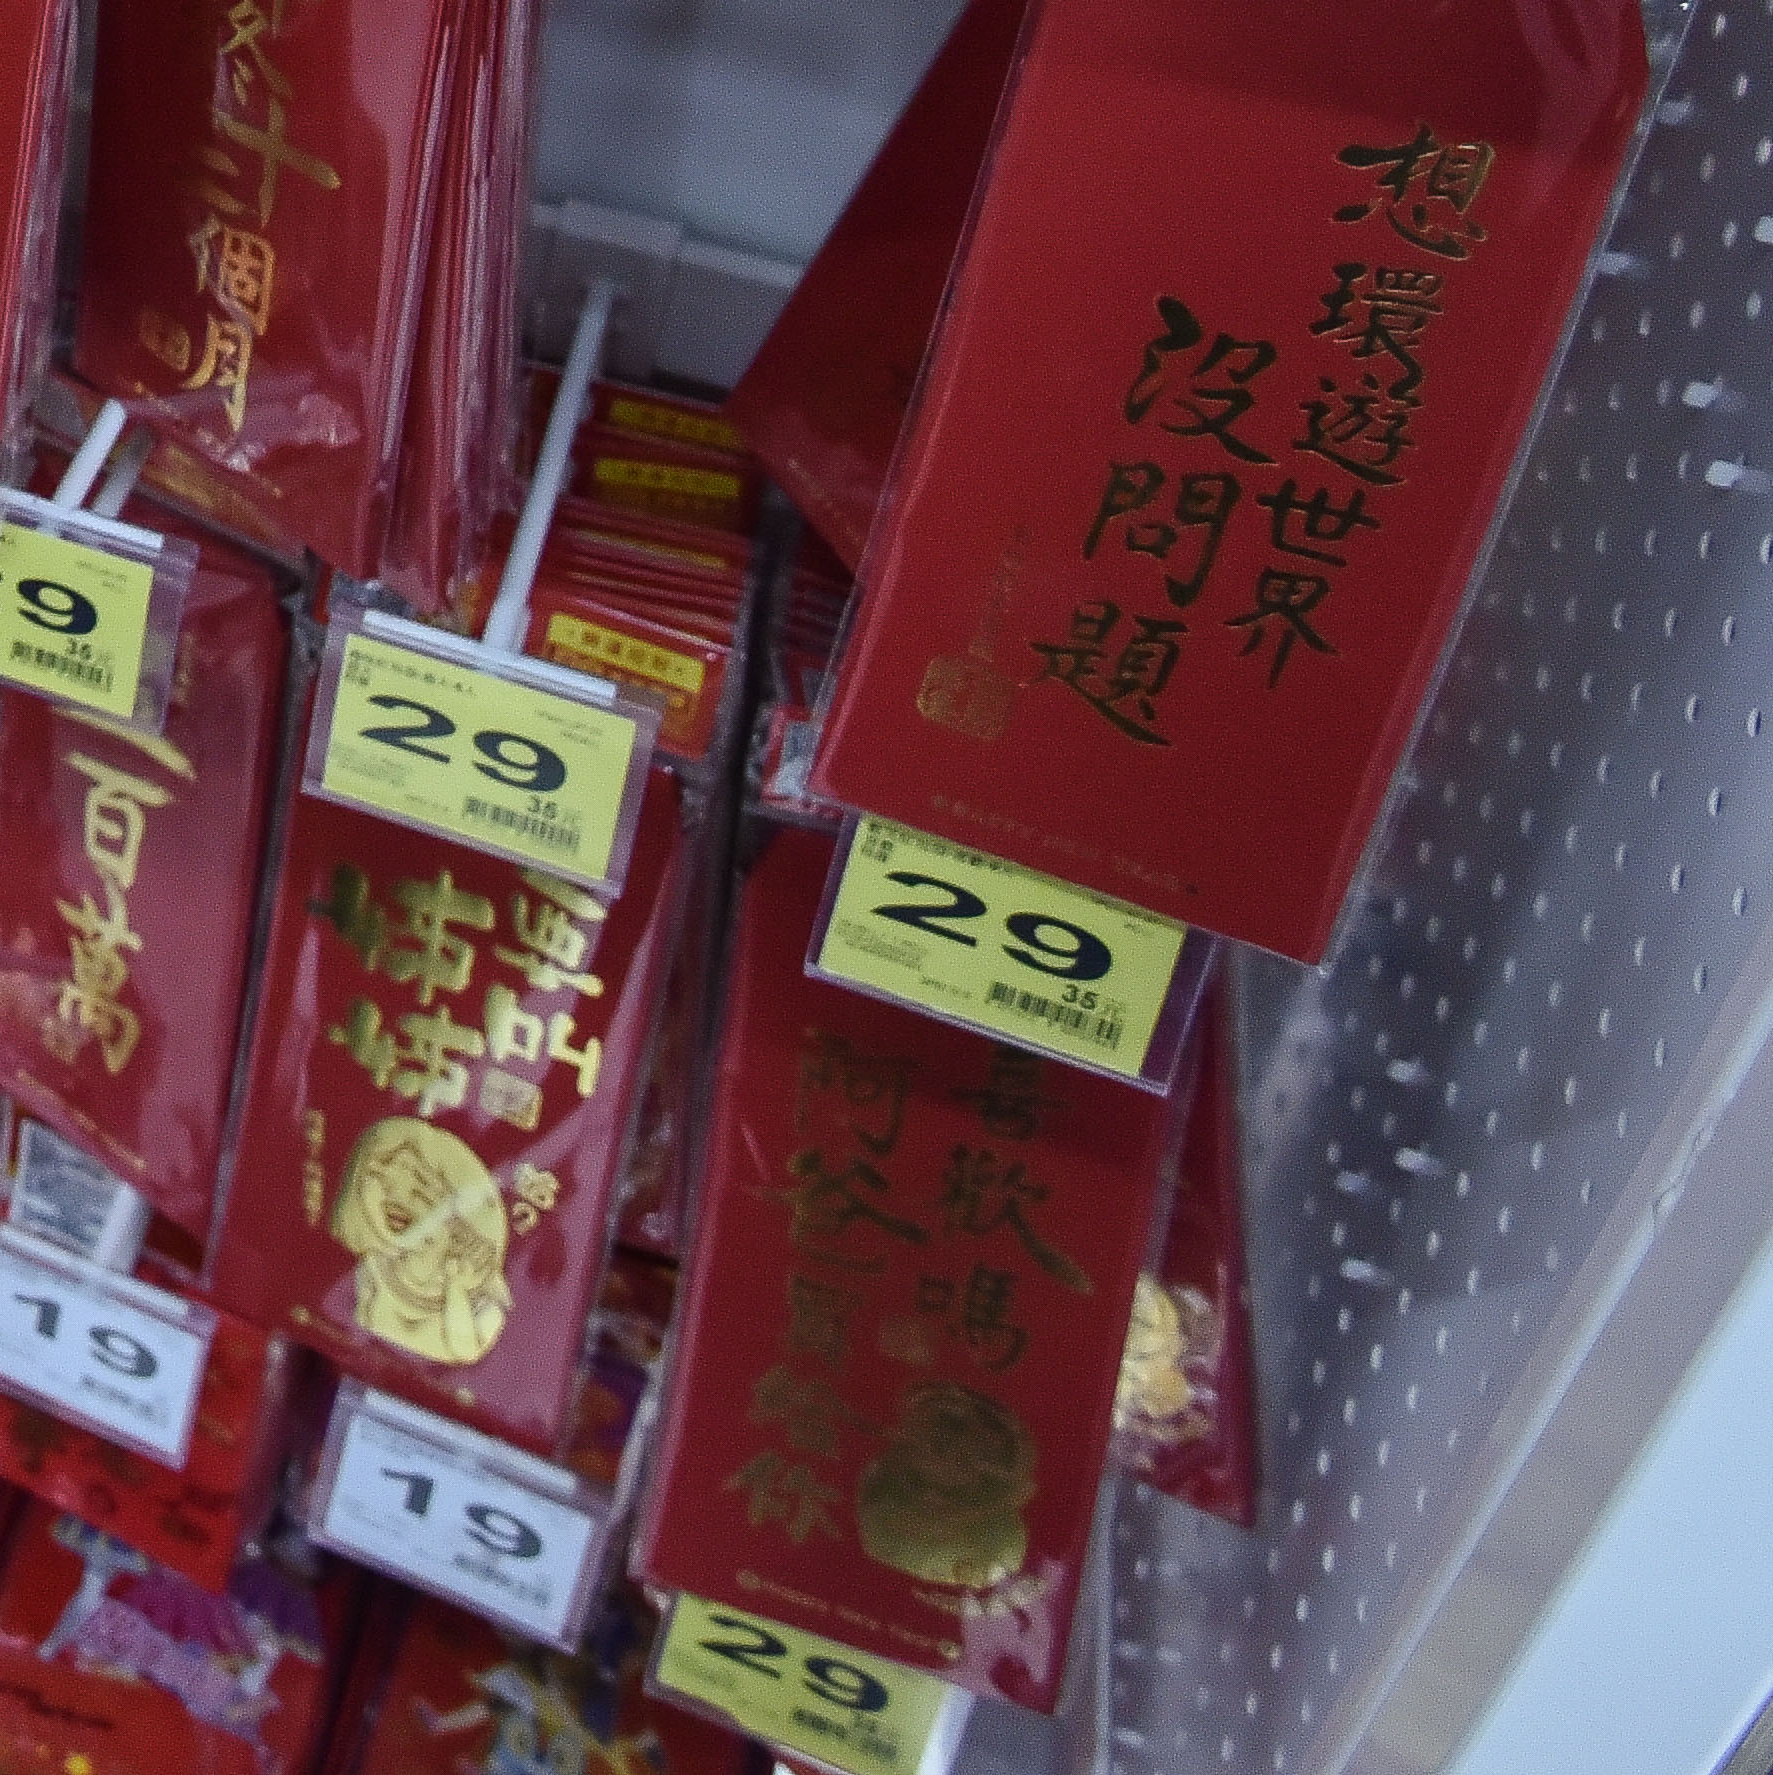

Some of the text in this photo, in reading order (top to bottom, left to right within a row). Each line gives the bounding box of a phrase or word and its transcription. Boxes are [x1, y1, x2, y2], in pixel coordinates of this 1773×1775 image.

[1223, 126, 1497, 691] 想環遊世界
[1025, 295, 1281, 747] 沒問題
[359, 694, 566, 793] 29
[870, 870, 1113, 981] 29
[14, 1292, 159, 1382] 19
[380, 1466, 545, 1562] 19
[698, 1613, 891, 1716] 29
